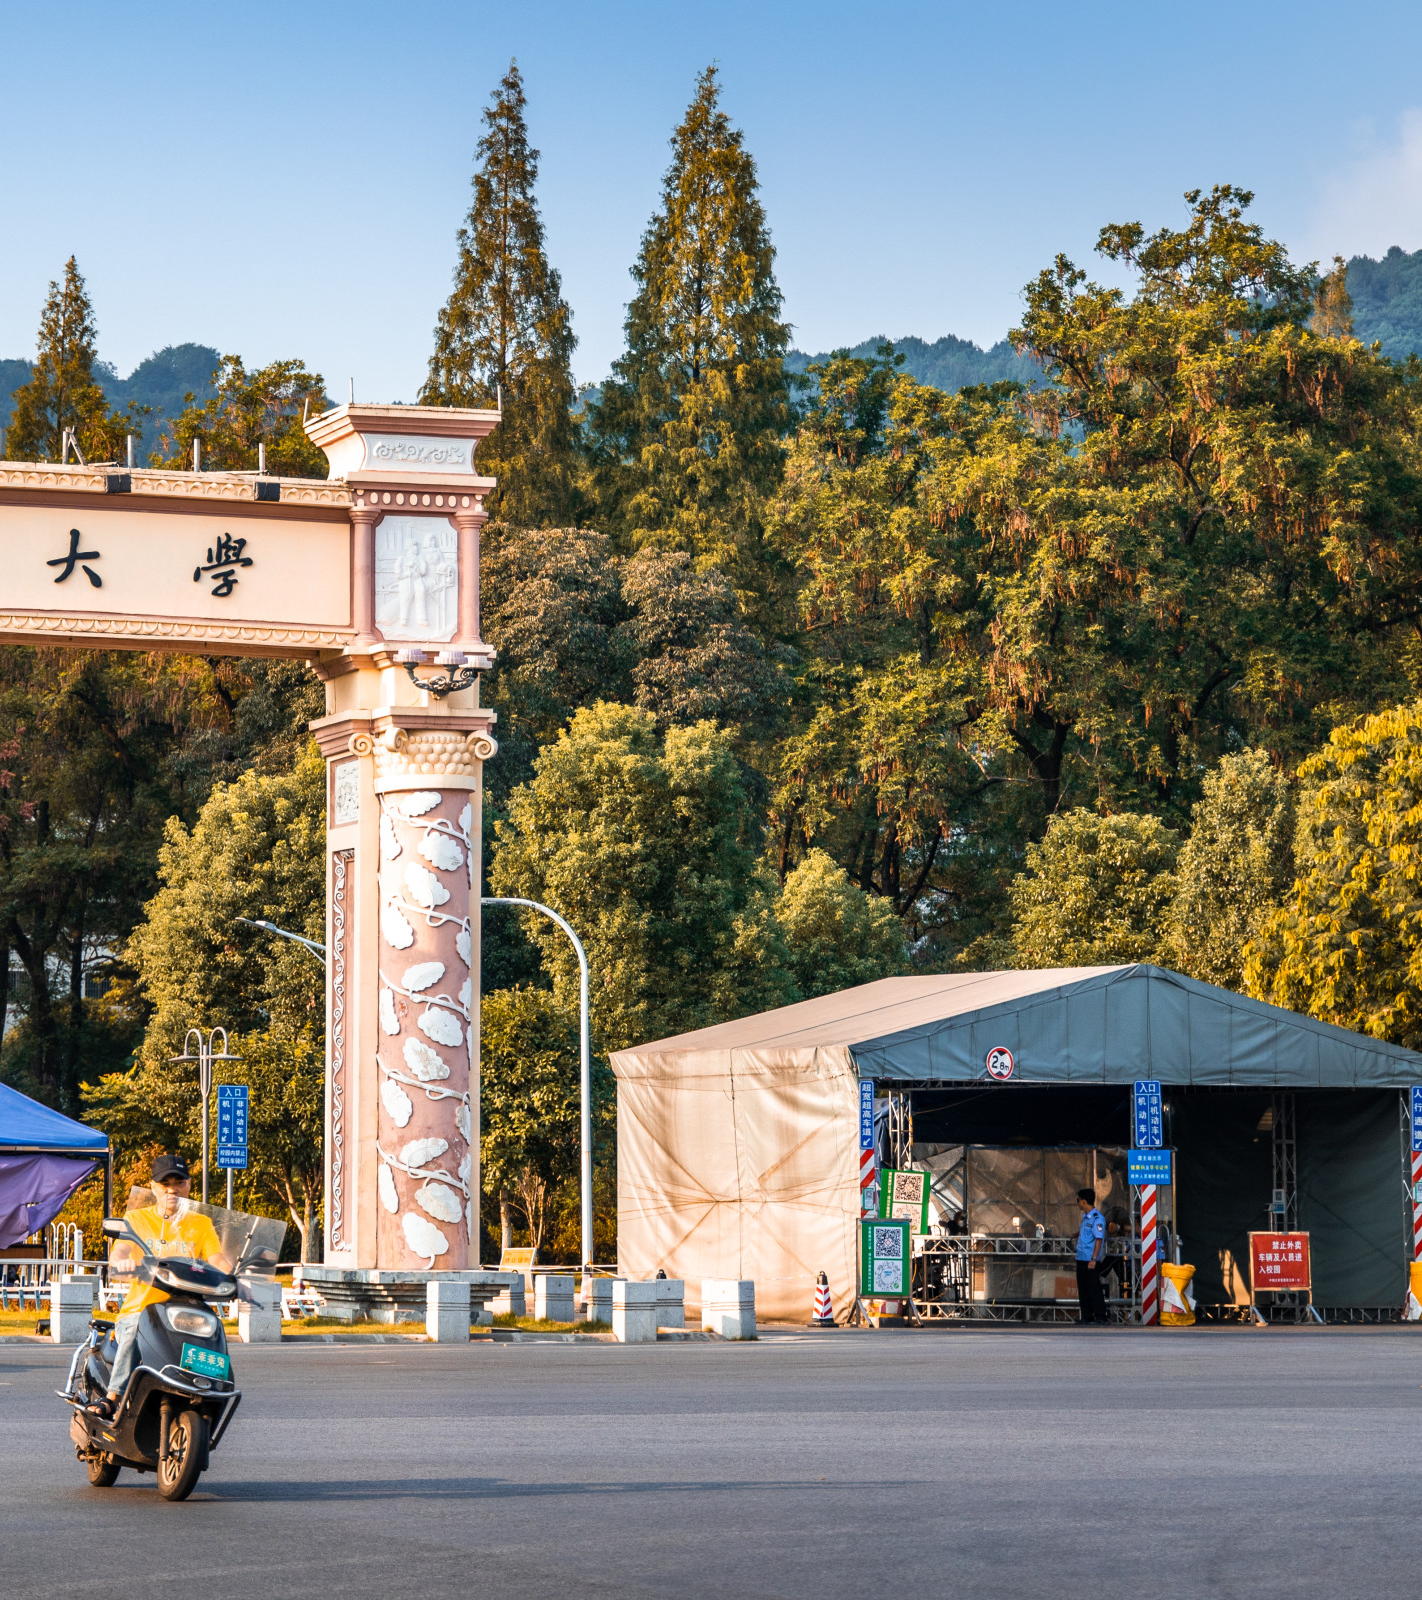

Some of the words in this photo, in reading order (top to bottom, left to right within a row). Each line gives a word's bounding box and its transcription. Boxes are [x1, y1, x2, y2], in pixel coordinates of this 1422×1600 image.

[224, 1087, 242, 1097] 入口
[1139, 1082, 1156, 1093] 入口
[861, 1083, 872, 1136] 超宽超高车道
[1138, 1096, 1148, 1133] 机动车
[221, 1100, 231, 1135] 机动车
[235, 1100, 245, 1135] 非机动车
[1149, 1096, 1160, 1135] 非机动车
[219, 1149, 246, 1157] 校园内禁止
[1271, 1240, 1302, 1250] 禁止外卖
[1258, 1252, 1303, 1262] 车辆及人员进
[1258, 1264, 1281, 1275] 入校园
